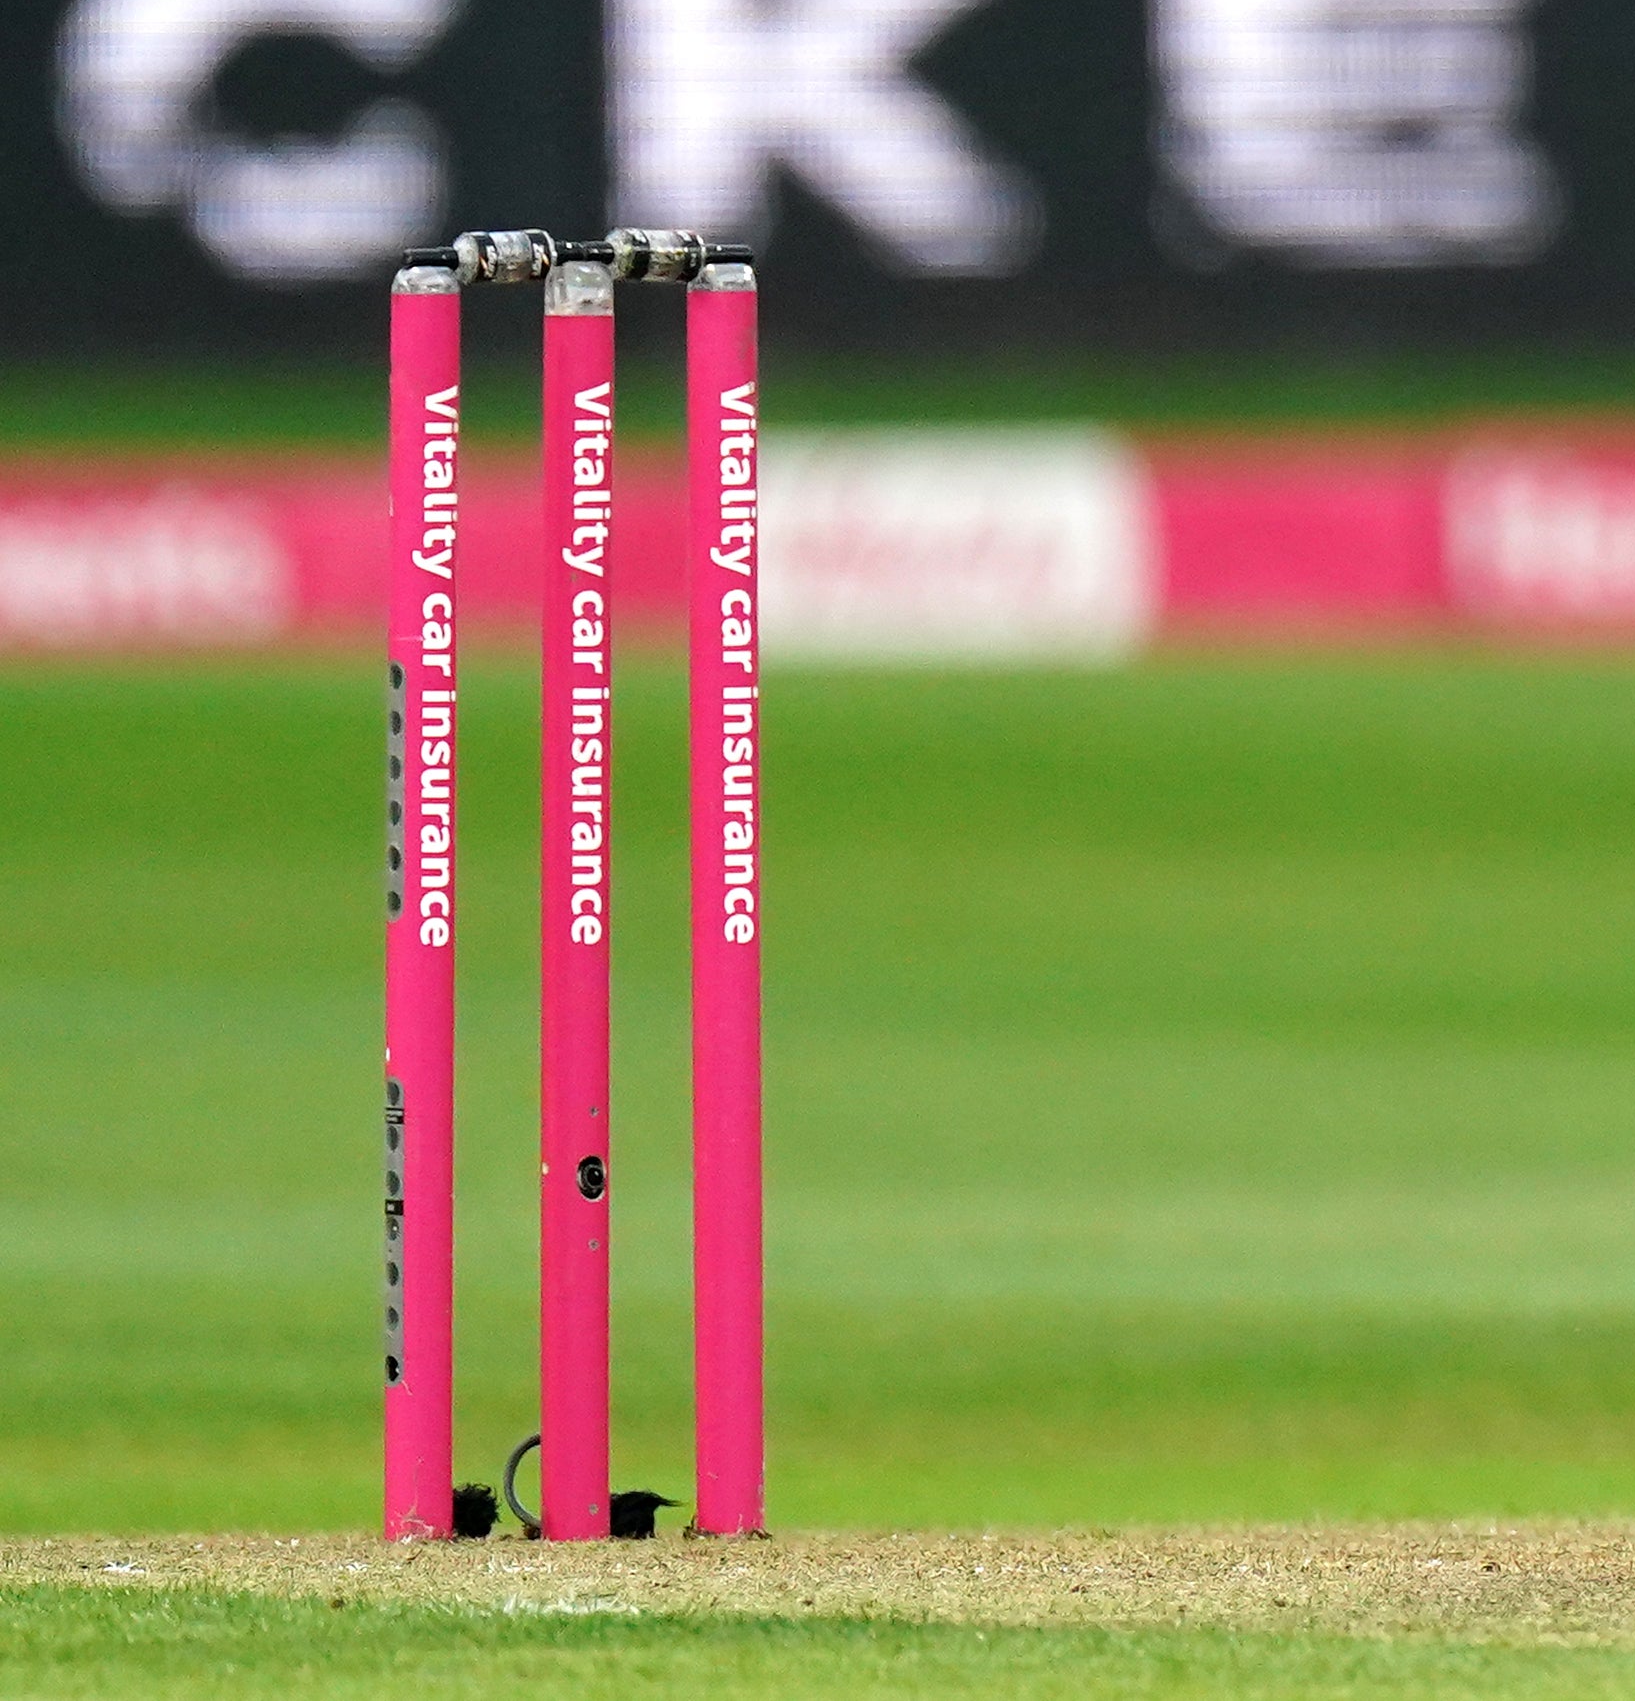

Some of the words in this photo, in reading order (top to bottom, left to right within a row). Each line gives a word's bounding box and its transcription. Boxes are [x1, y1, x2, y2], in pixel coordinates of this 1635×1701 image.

[411, 385, 459, 580] Vitality
[562, 381, 612, 577] Vitality
[710, 381, 757, 578] Vitality
[420, 592, 453, 677] car
[572, 589, 604, 674] car
[721, 589, 754, 674] car
[419, 690, 457, 947] insurance
[570, 687, 610, 945] insurance
[722, 686, 759, 944] insurance
